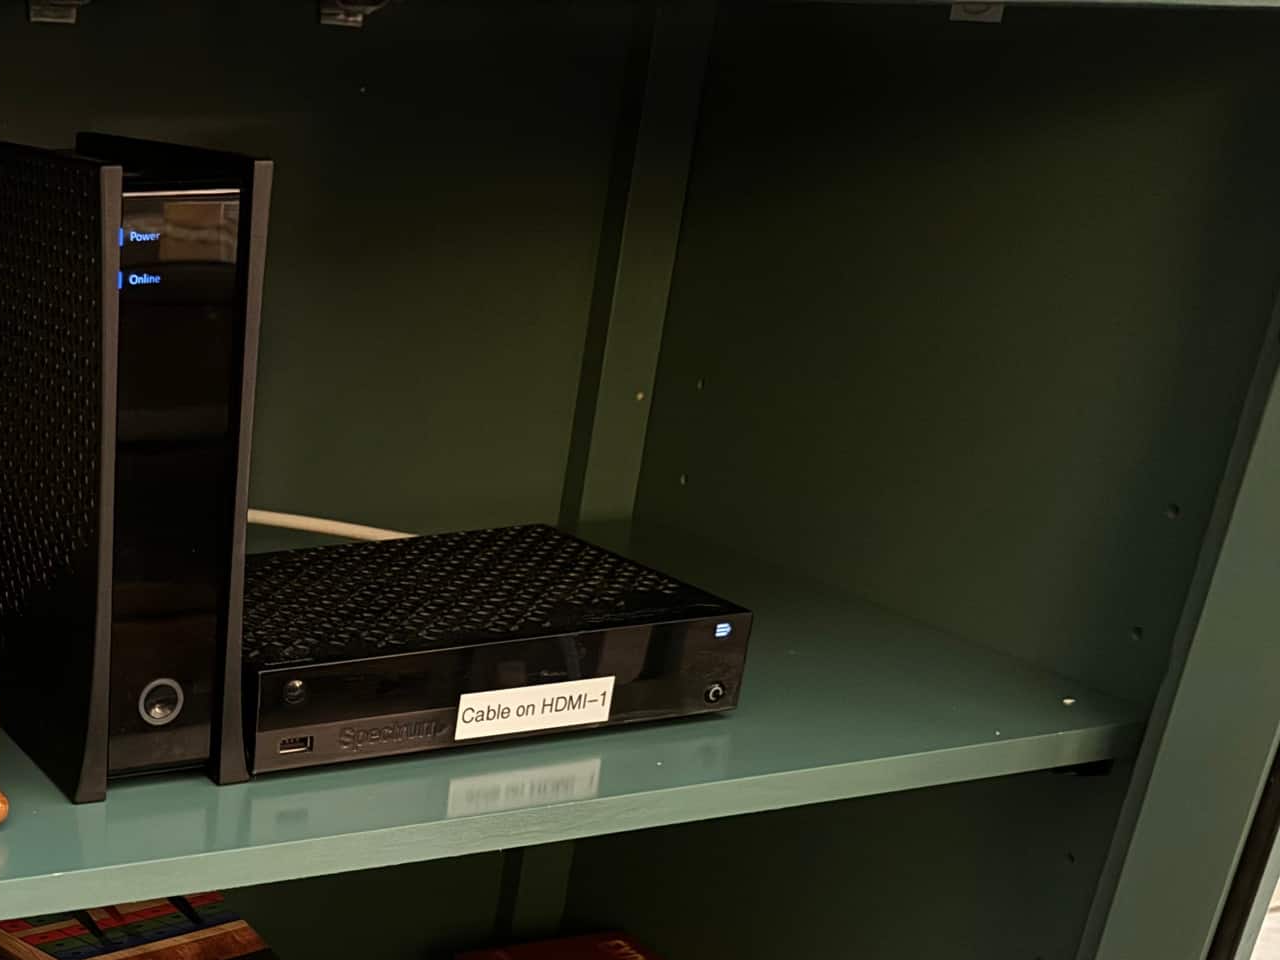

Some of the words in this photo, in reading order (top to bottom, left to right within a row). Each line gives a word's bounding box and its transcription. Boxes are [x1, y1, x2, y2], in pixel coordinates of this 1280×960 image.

[129, 230, 161, 242] Power
[129, 273, 161, 285] Online
[461, 702, 511, 726] Cable
[515, 703, 535, 719] on
[540, 690, 608, 716] HDMI-1
